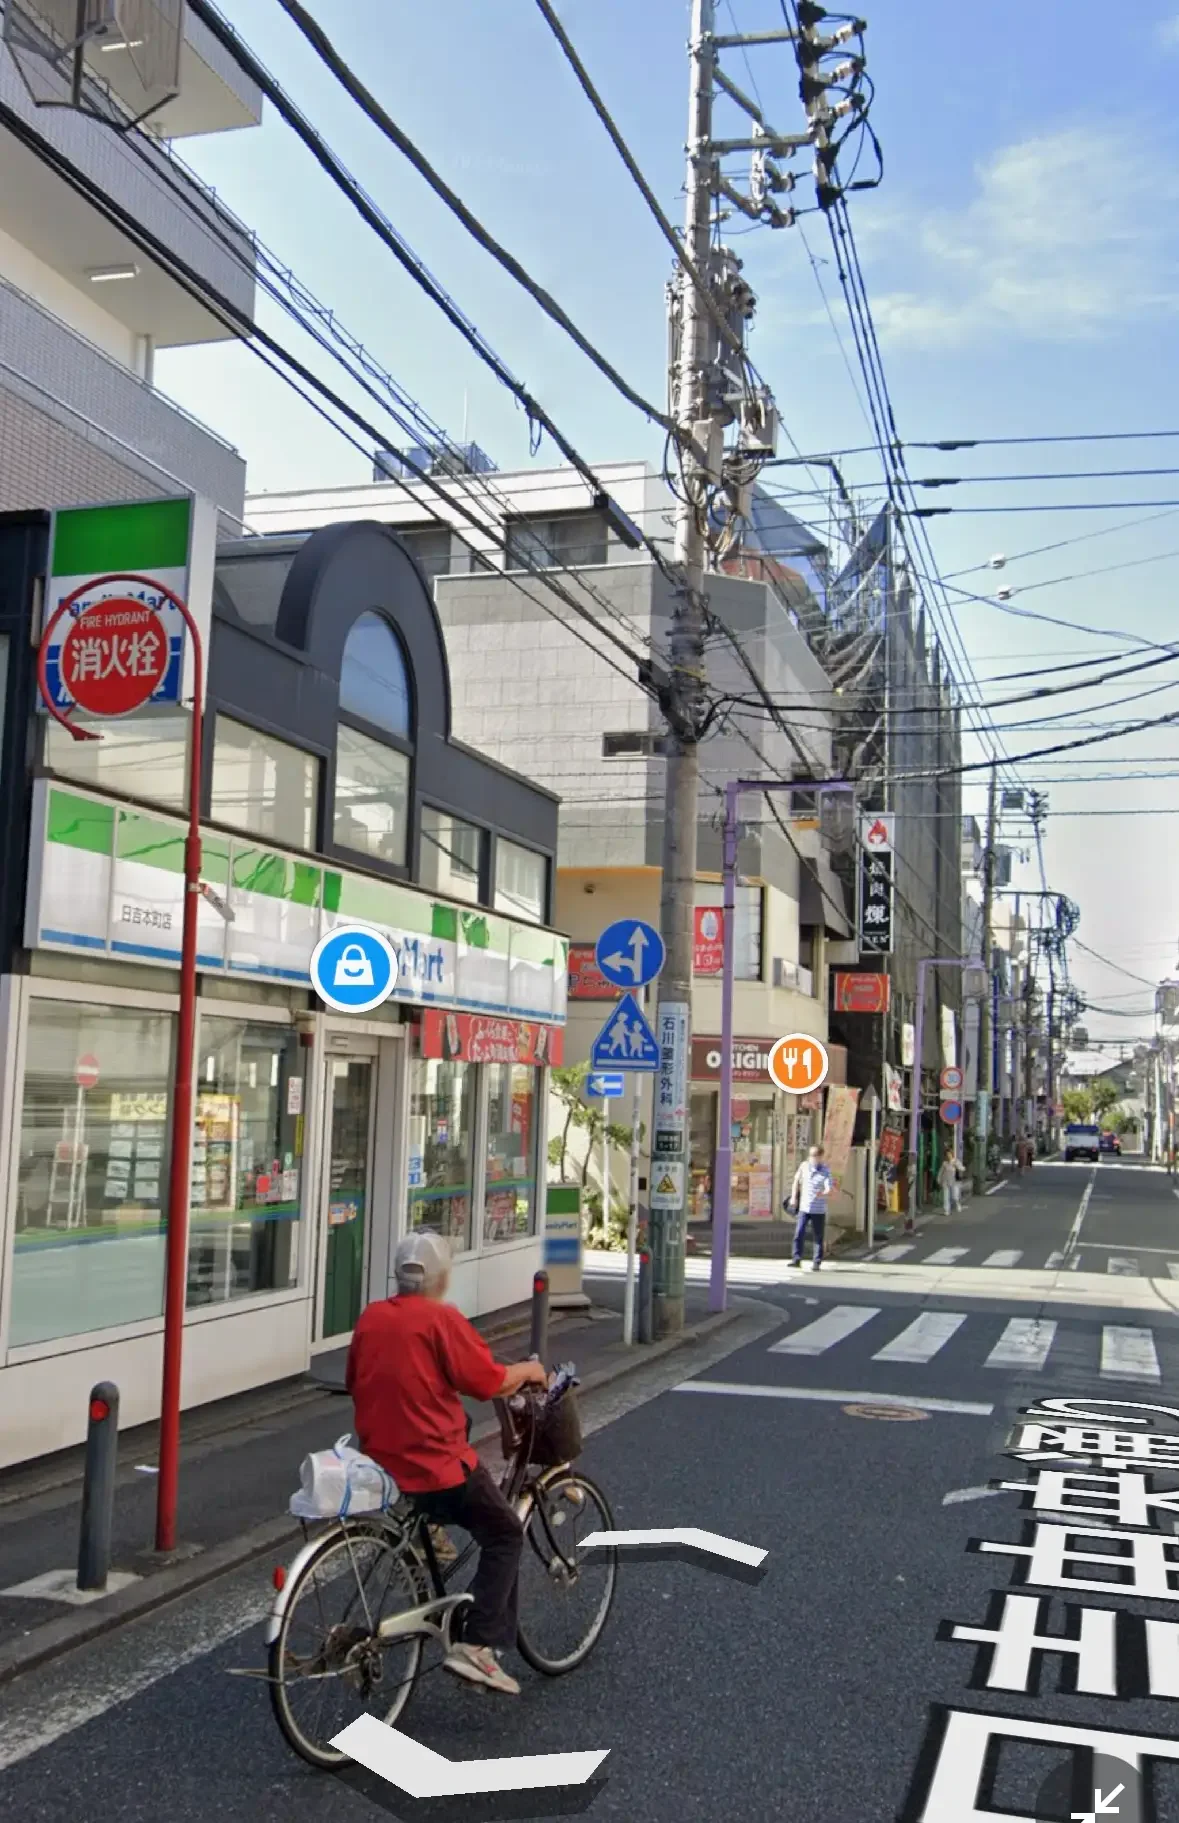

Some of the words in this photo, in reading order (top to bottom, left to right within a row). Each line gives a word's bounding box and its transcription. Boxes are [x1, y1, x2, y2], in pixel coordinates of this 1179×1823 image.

[80, 614, 101, 629] FIRE
[104, 611, 150, 628] HYDRANT
[71, 630, 161, 682] 消火栓
[122, 904, 173, 928] 日吉本町店
[659, 1016, 675, 1106] 石川整形外科
